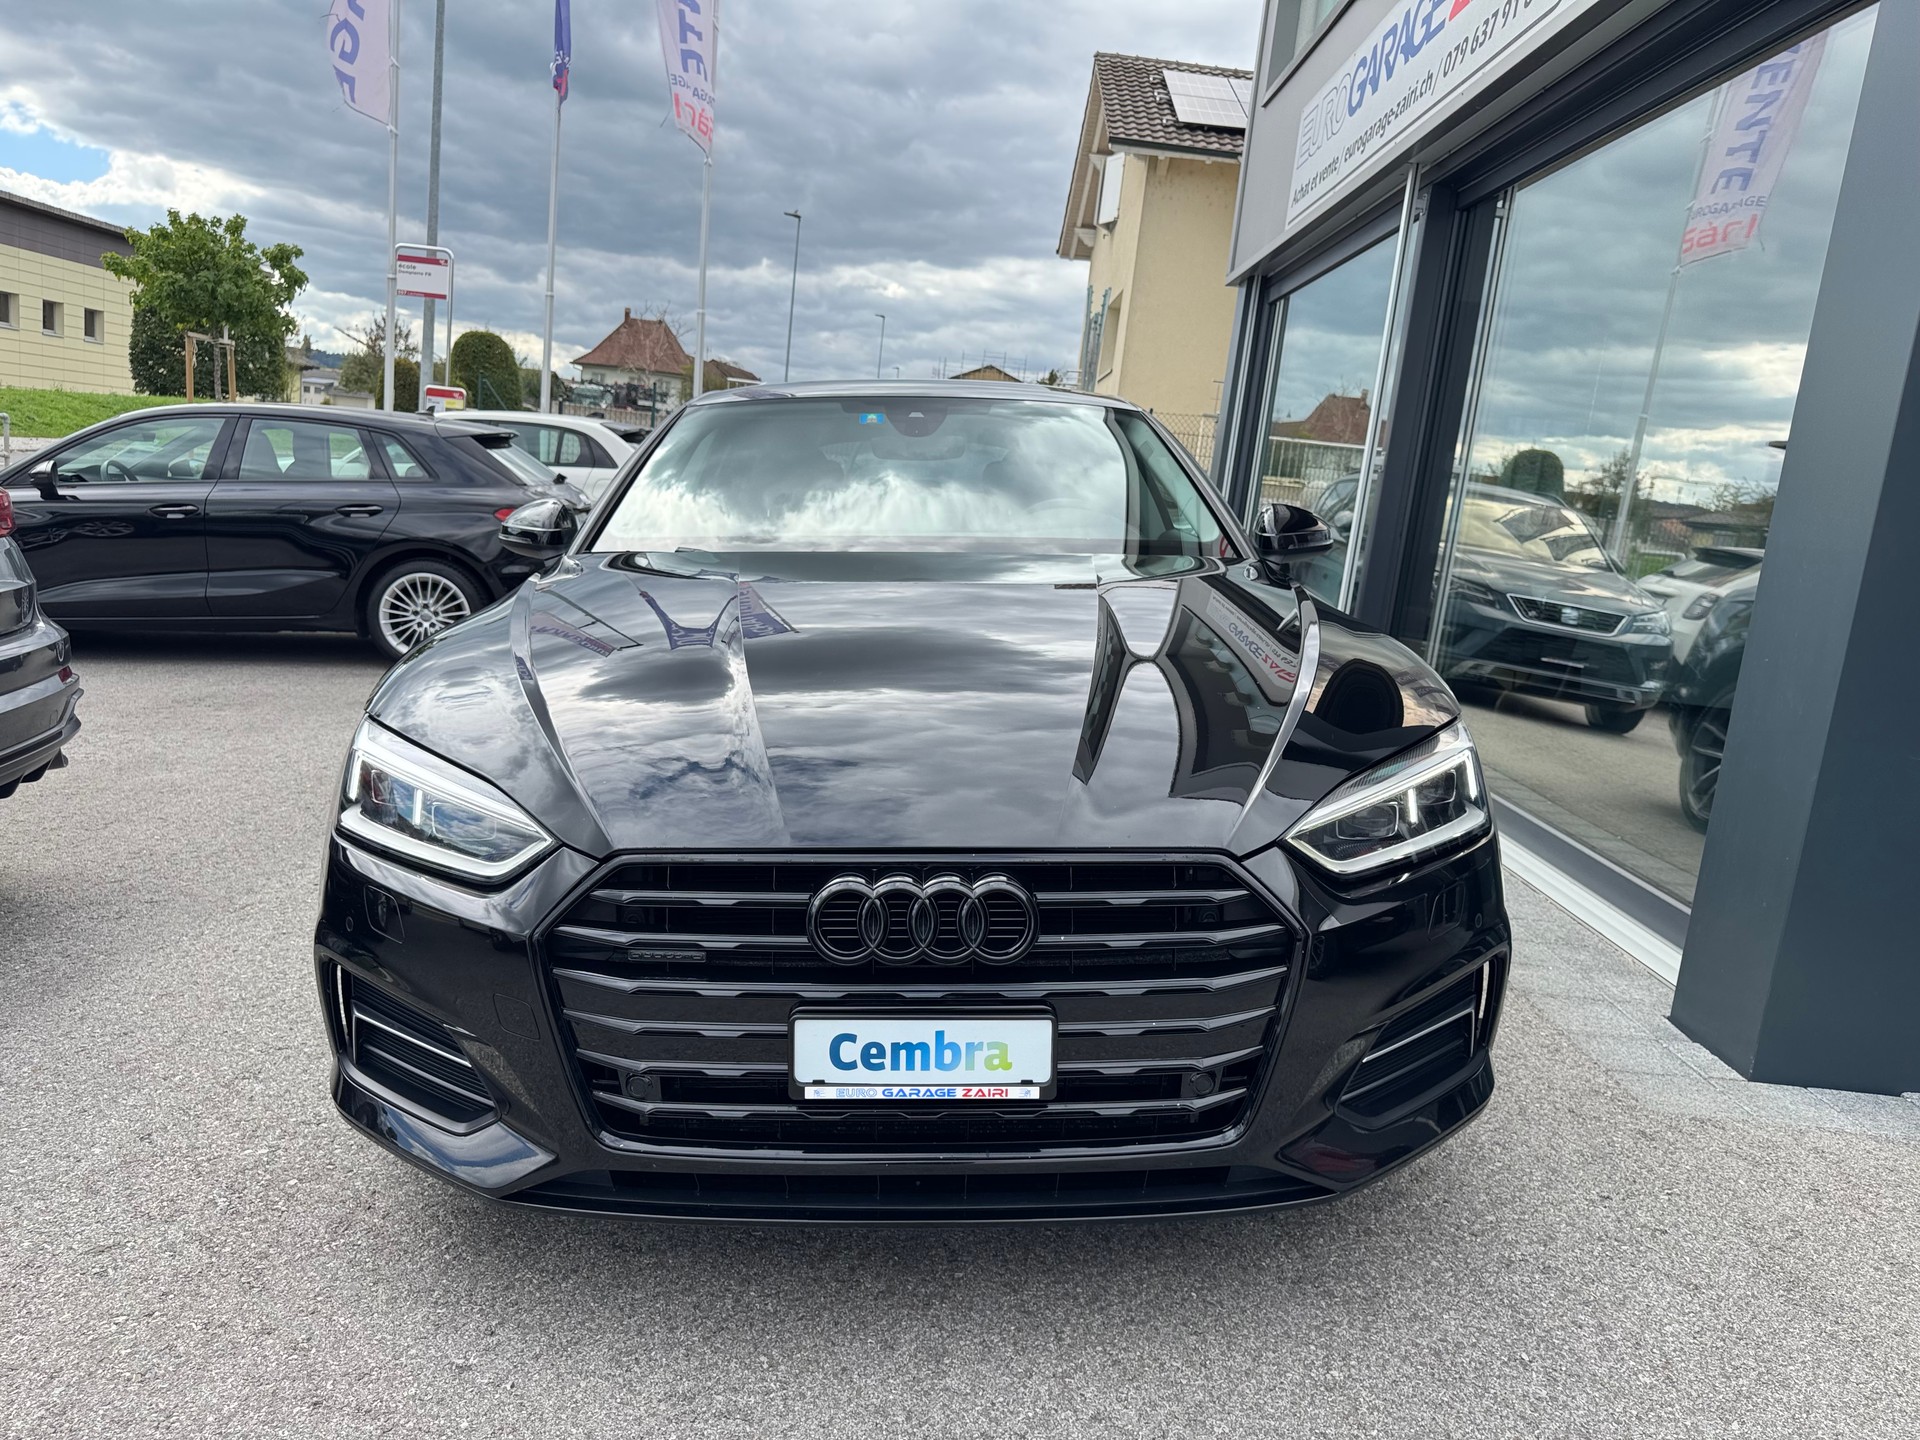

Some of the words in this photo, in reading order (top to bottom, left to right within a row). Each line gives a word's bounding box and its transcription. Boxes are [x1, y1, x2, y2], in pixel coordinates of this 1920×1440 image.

[1291, 177, 1311, 208] Achat
[1310, 170, 1318, 190] et
[1319, 154, 1339, 185] vente
[1344, 69, 1434, 162] eurogarage-zairi.ch
[1443, 36, 1469, 78] 079
[1470, 7, 1500, 55] 637
[829, 1030, 1013, 1072] Cembra
[835, 1088, 877, 1098] EURO
[882, 1088, 957, 1098] GARAGE
[961, 1088, 1009, 1098] ZAIRI
